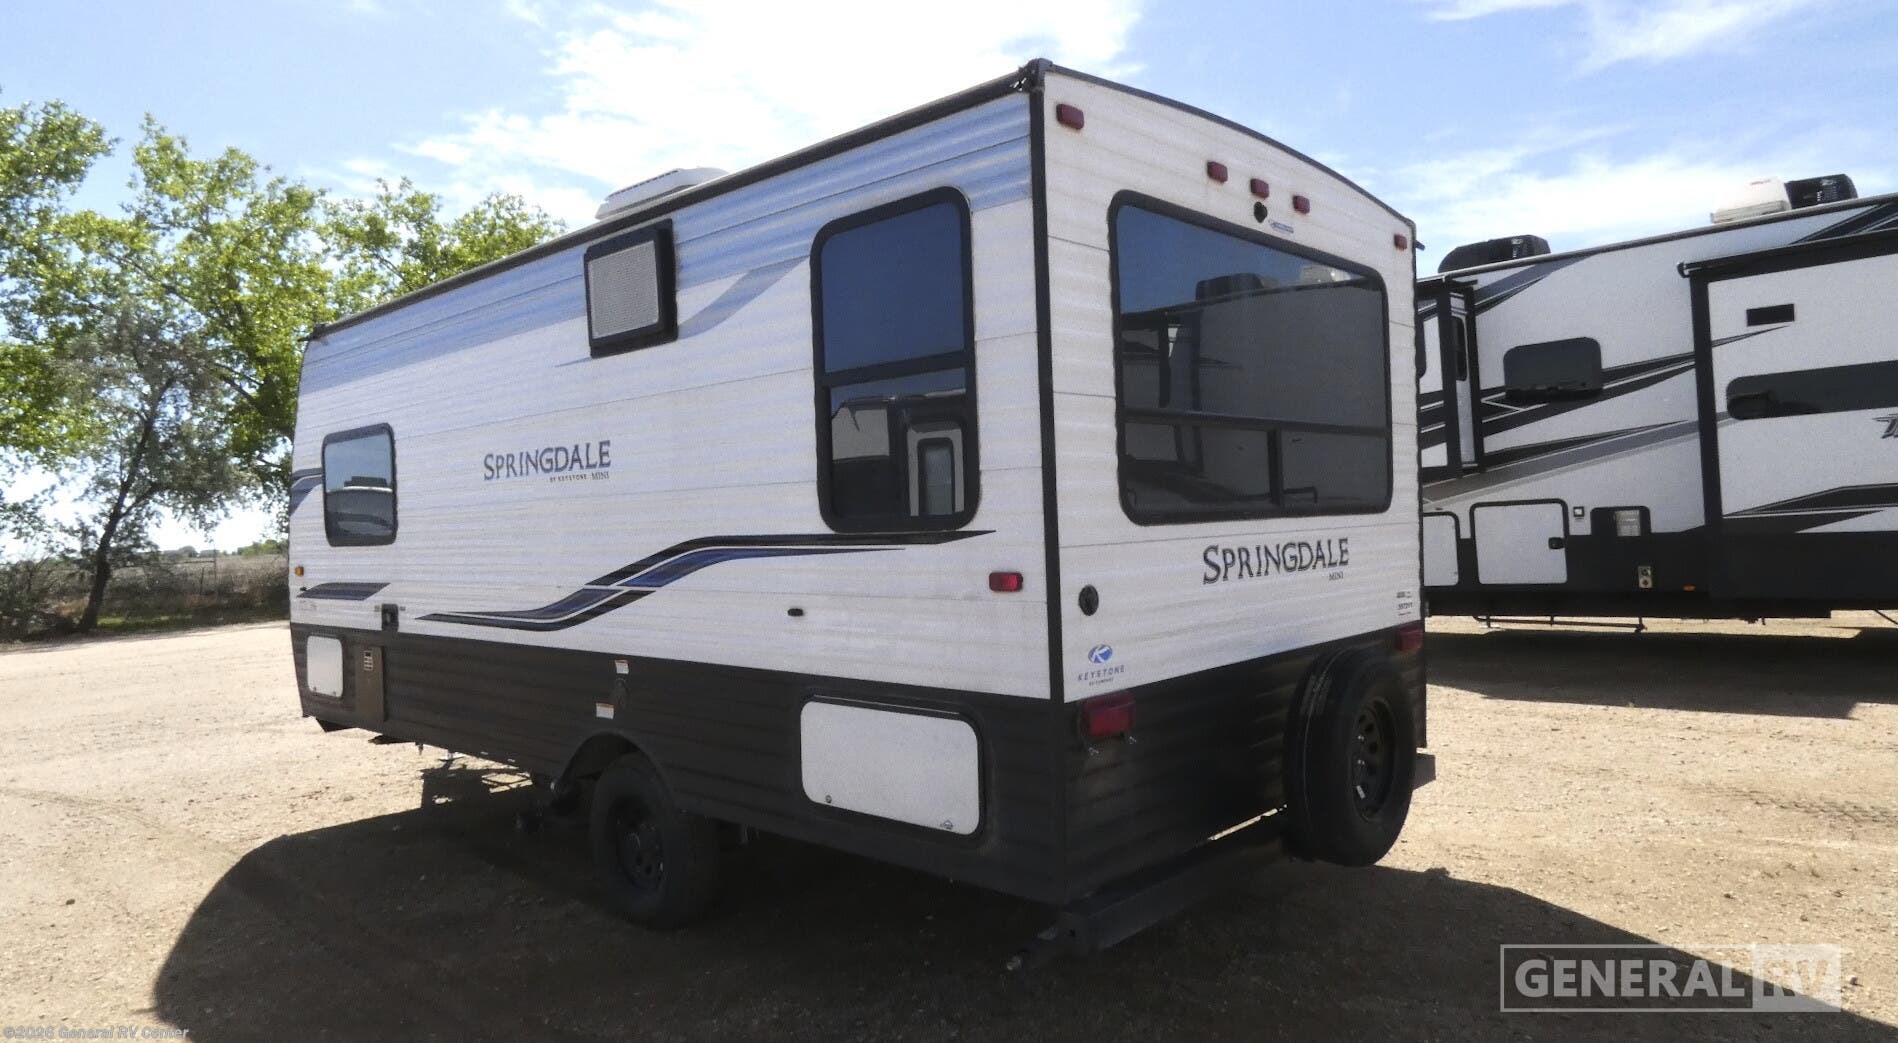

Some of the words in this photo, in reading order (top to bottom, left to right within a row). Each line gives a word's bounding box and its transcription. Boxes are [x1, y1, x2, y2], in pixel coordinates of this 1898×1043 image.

[483, 440, 611, 480] SPRINGDALE
[591, 471, 610, 480] MINI
[1203, 537, 1349, 585] SPRINGDALE
[1328, 571, 1344, 581] MINI
[1078, 665, 1125, 681] KEYSTONE
